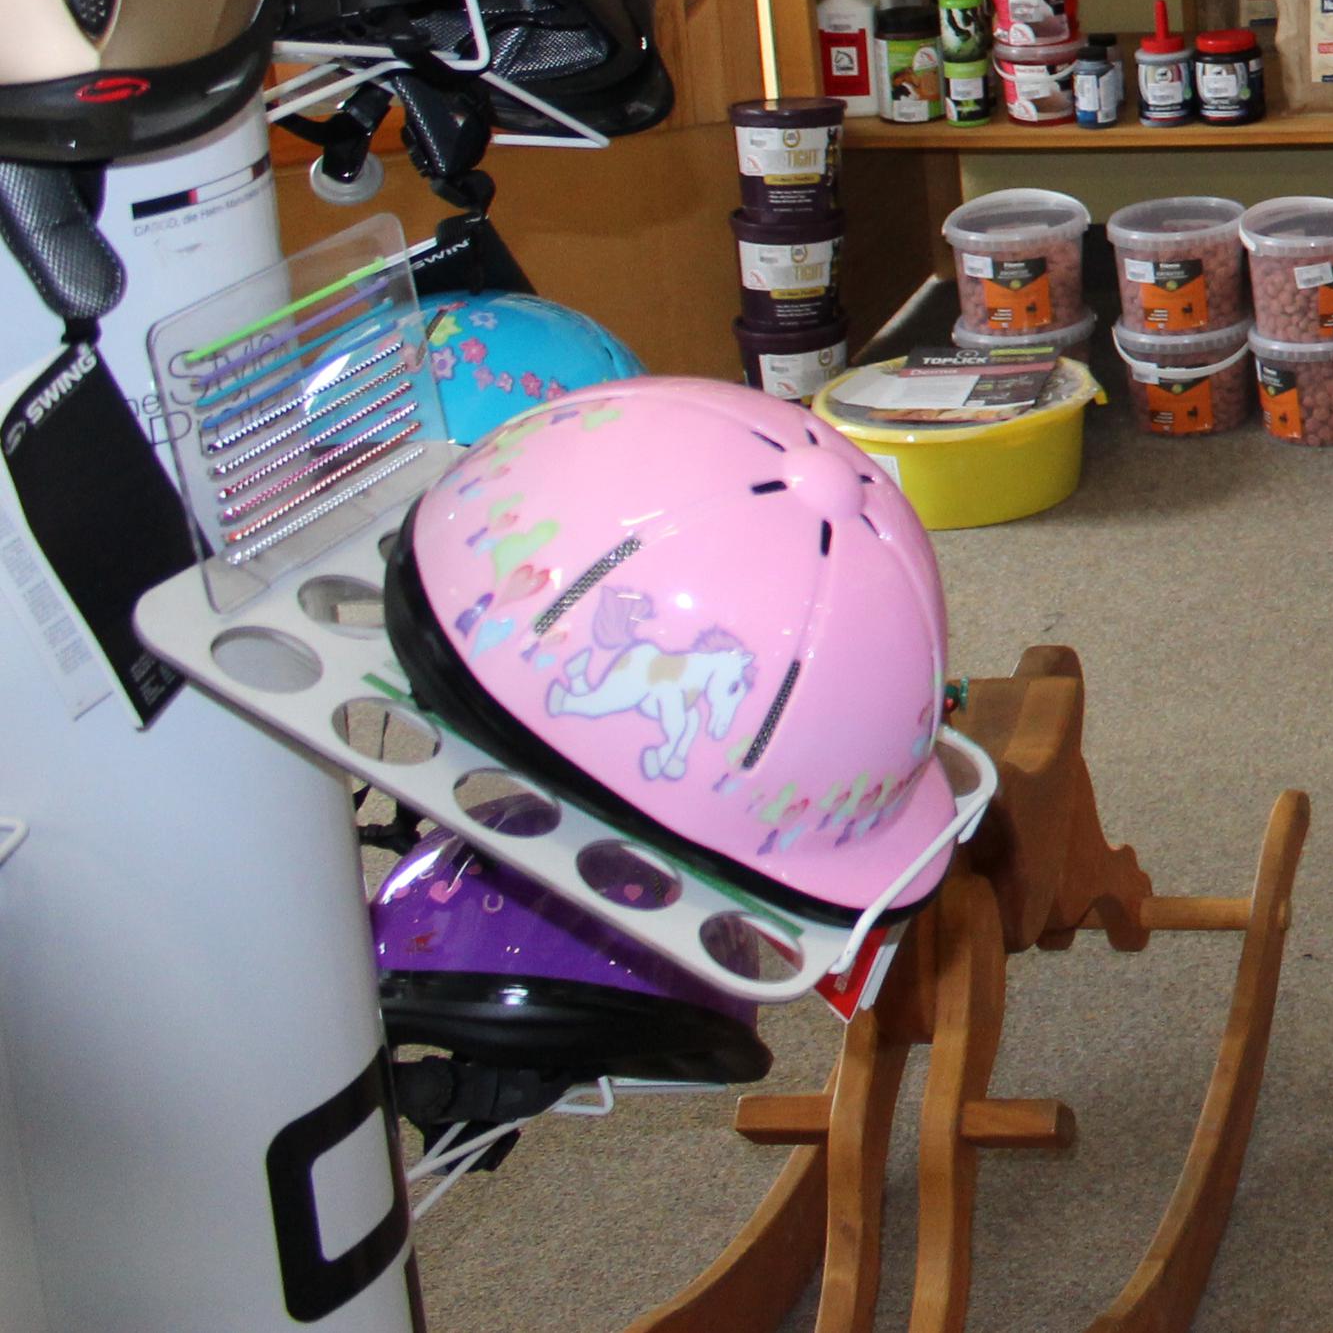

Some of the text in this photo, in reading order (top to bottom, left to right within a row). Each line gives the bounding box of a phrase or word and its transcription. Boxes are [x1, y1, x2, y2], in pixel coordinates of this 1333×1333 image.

[410, 237, 470, 269] SWIN
[922, 356, 988, 365] TOPLICK
[26, 346, 98, 427] SWING
